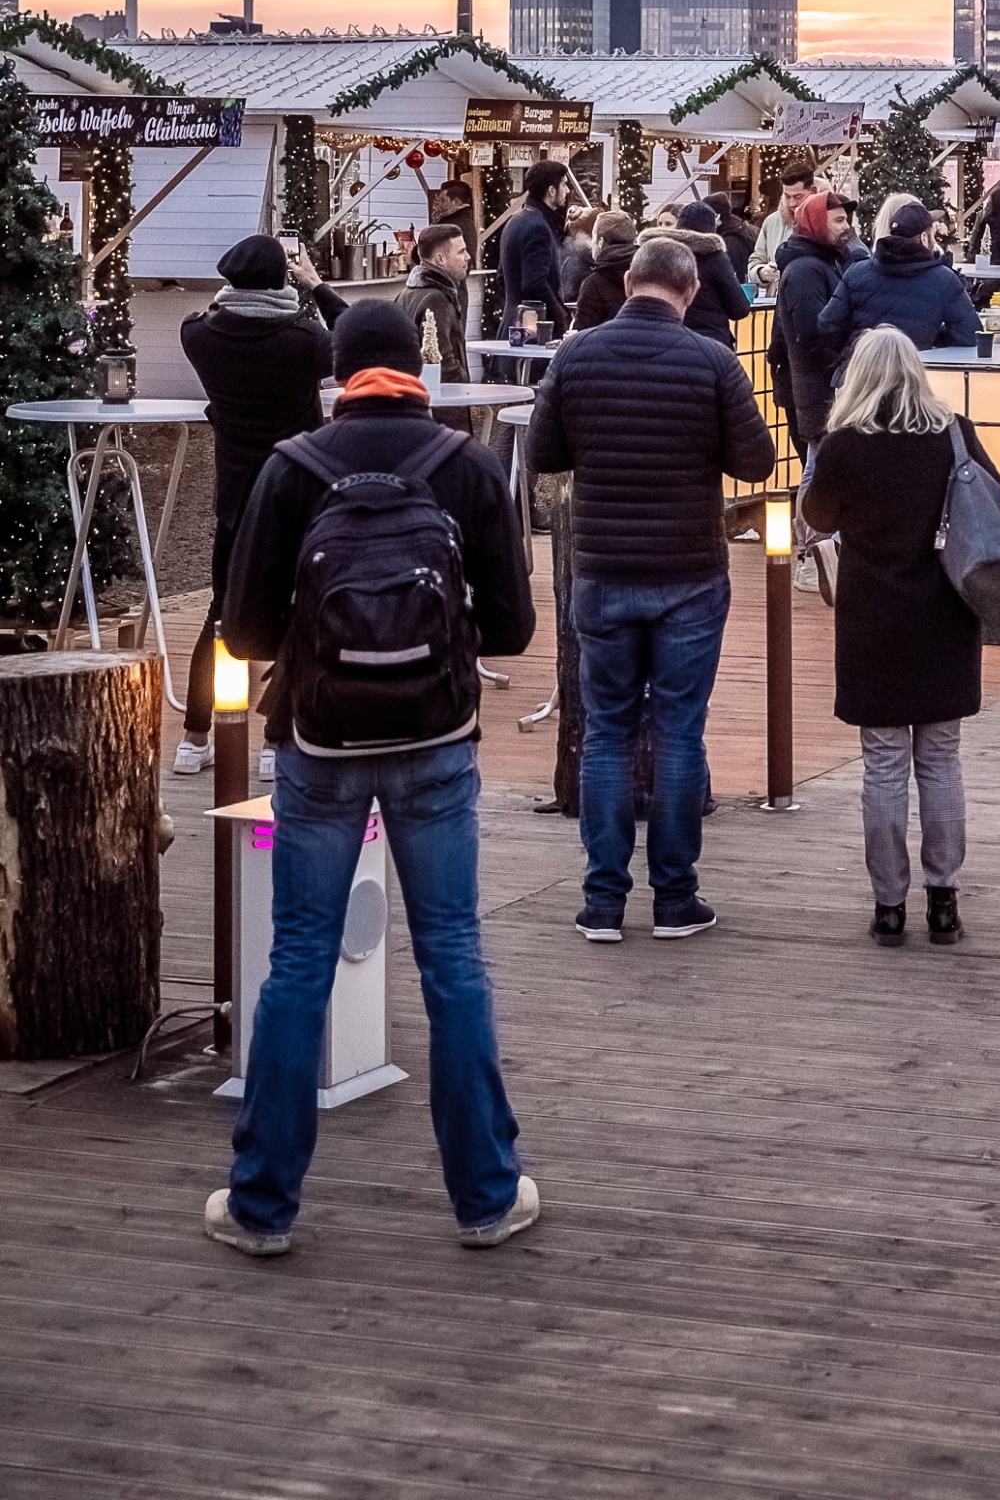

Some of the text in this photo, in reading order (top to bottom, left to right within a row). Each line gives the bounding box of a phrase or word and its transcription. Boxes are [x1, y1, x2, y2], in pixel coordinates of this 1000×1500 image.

[34, 98, 59, 113] frische
[166, 100, 196, 122] Winzer
[523, 106, 553, 120] Burger
[38, 105, 135, 137] ische Waffeln
[465, 117, 512, 133] GLÜHWEIN
[520, 120, 553, 133] Pommes
[557, 119, 589, 133] ÄPPLER
[144, 116, 218, 142] Glühweine
